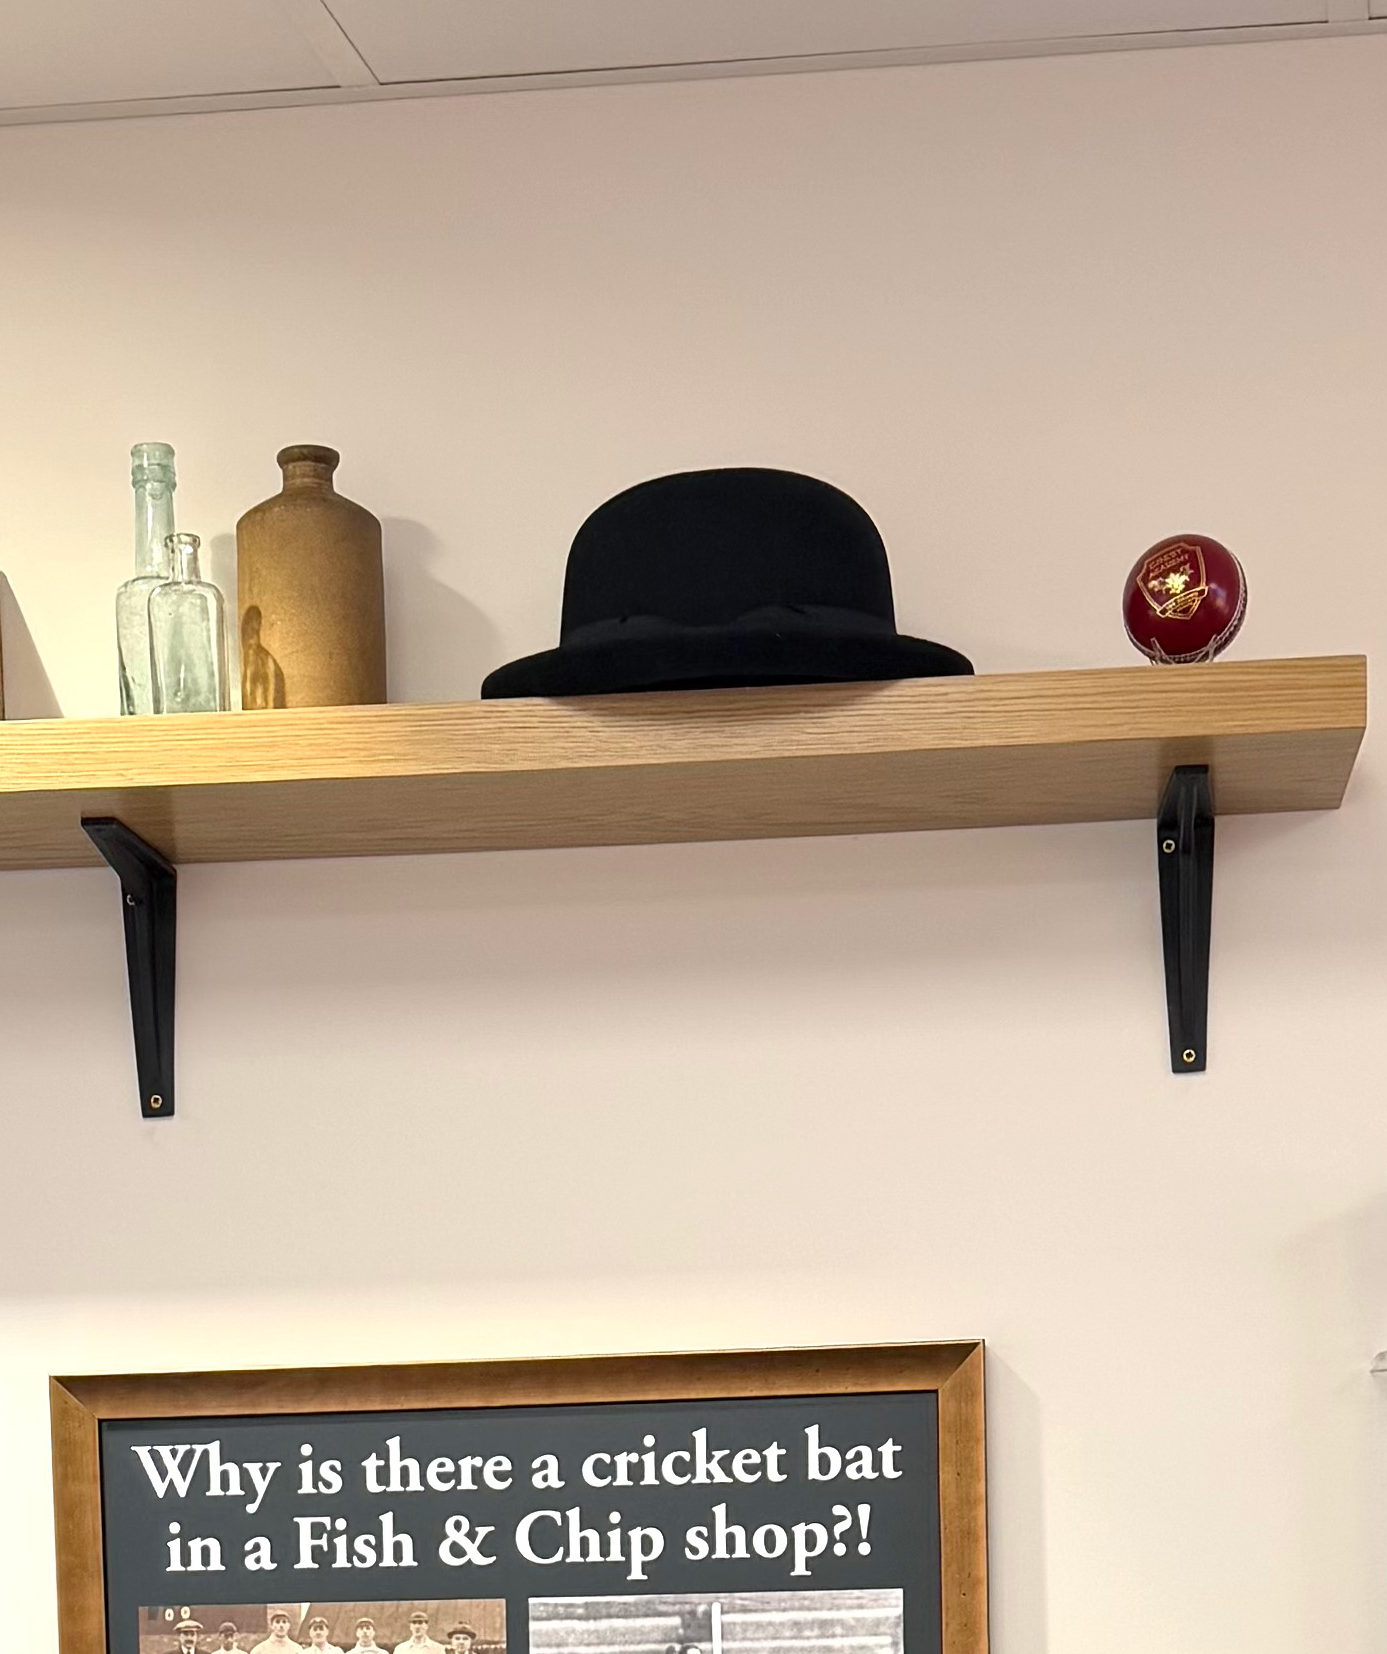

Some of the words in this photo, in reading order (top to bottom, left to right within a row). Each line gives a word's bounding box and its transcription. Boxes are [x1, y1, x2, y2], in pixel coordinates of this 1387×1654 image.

[131, 1440, 282, 1513] Why
[297, 1443, 342, 1494] is
[361, 1435, 512, 1493] there
[531, 1454, 565, 1489] a
[581, 1427, 787, 1487] cricket
[804, 1423, 902, 1480] bat
[165, 1521, 225, 1571] in
[244, 1536, 277, 1570] a
[293, 1511, 418, 1569] Fish
[438, 1514, 496, 1566] &
[515, 1506, 665, 1580] Chip
[684, 1503, 872, 1577] shop?!
